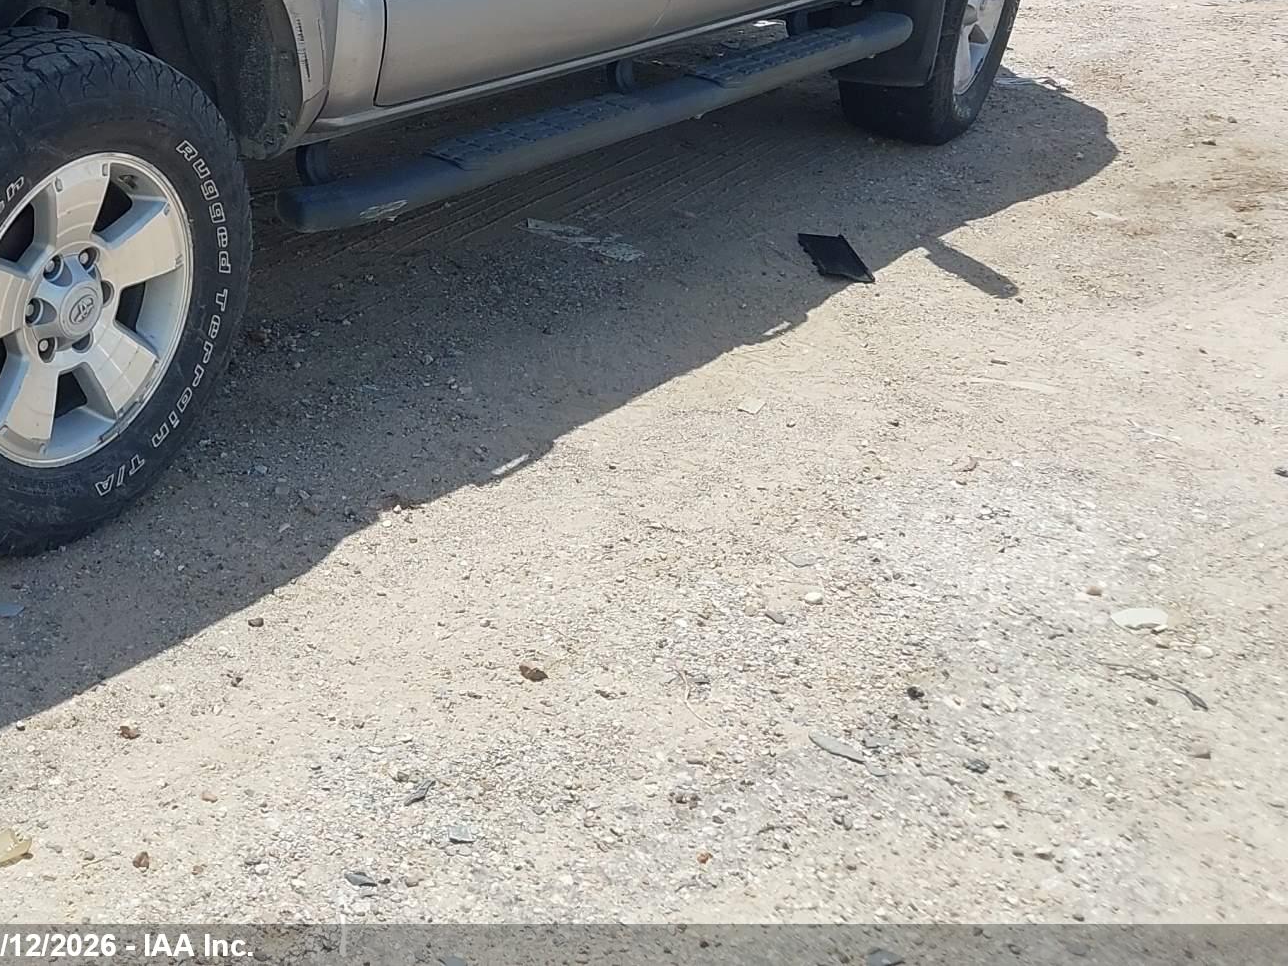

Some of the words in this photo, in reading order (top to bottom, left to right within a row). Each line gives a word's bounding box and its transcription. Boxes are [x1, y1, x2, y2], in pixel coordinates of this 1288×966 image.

[175, 139, 232, 275] Rugged
[151, 288, 229, 448] Terrain
[94, 453, 146, 497] T/A
